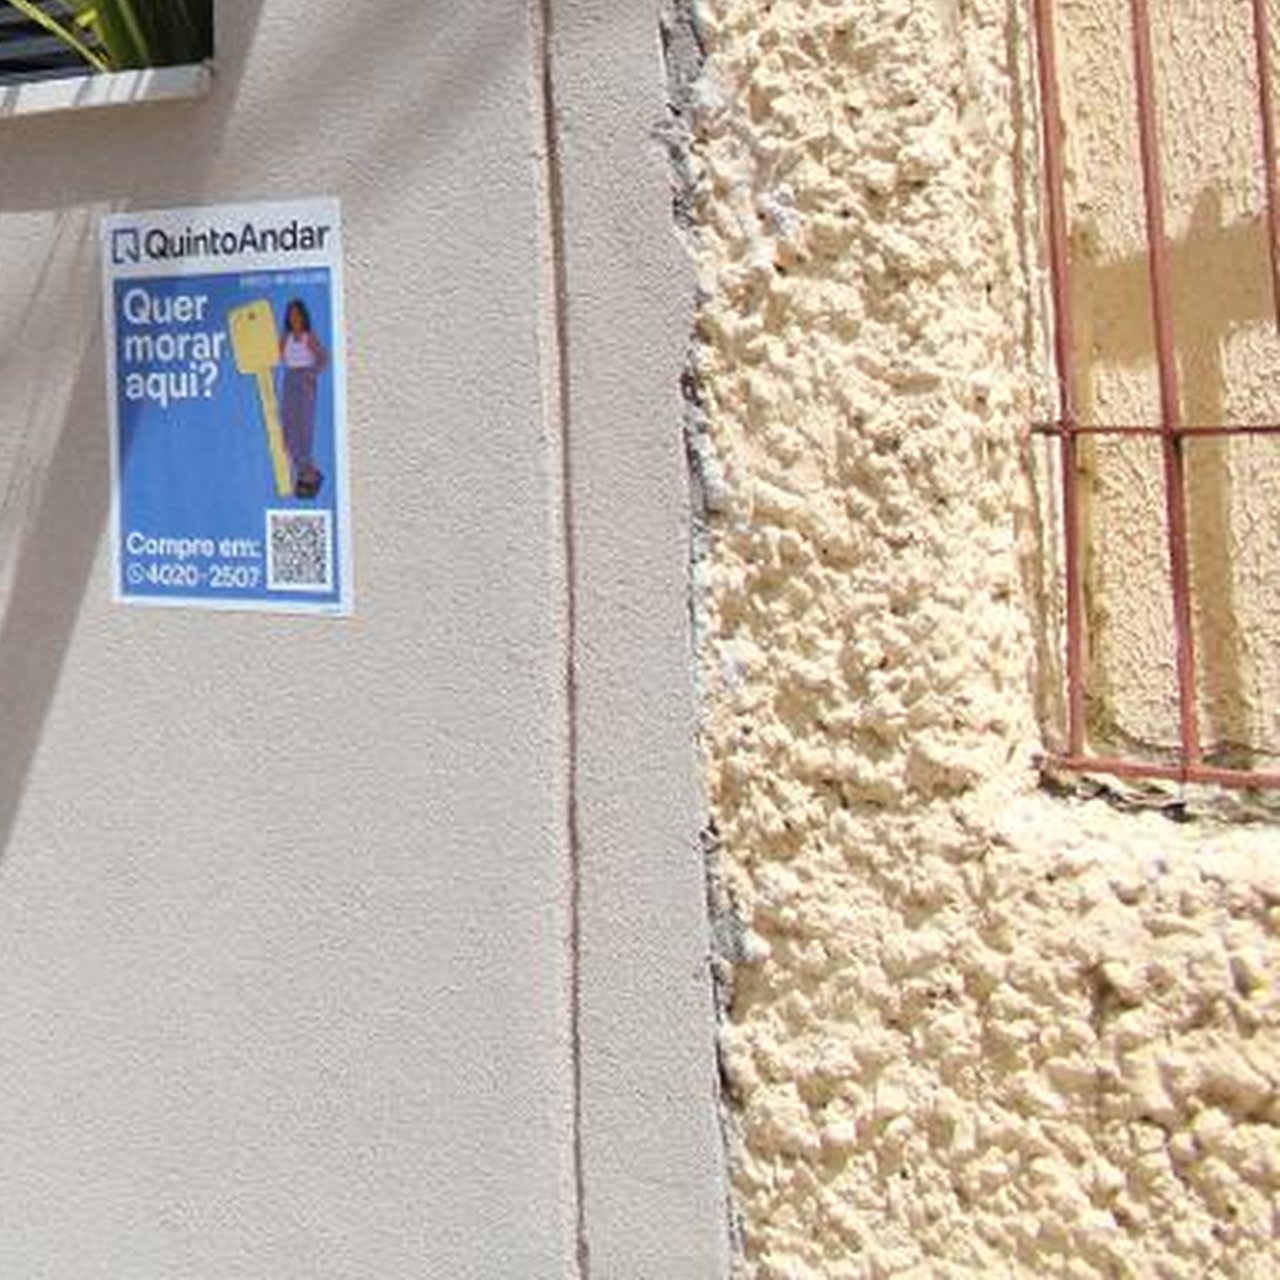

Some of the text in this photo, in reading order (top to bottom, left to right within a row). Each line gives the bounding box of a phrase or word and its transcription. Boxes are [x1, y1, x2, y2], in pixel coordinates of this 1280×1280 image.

[143, 221, 330, 261] QuintoAndar
[123, 288, 208, 324] Quer
[124, 331, 226, 363] morar
[125, 362, 219, 409] aqui?
